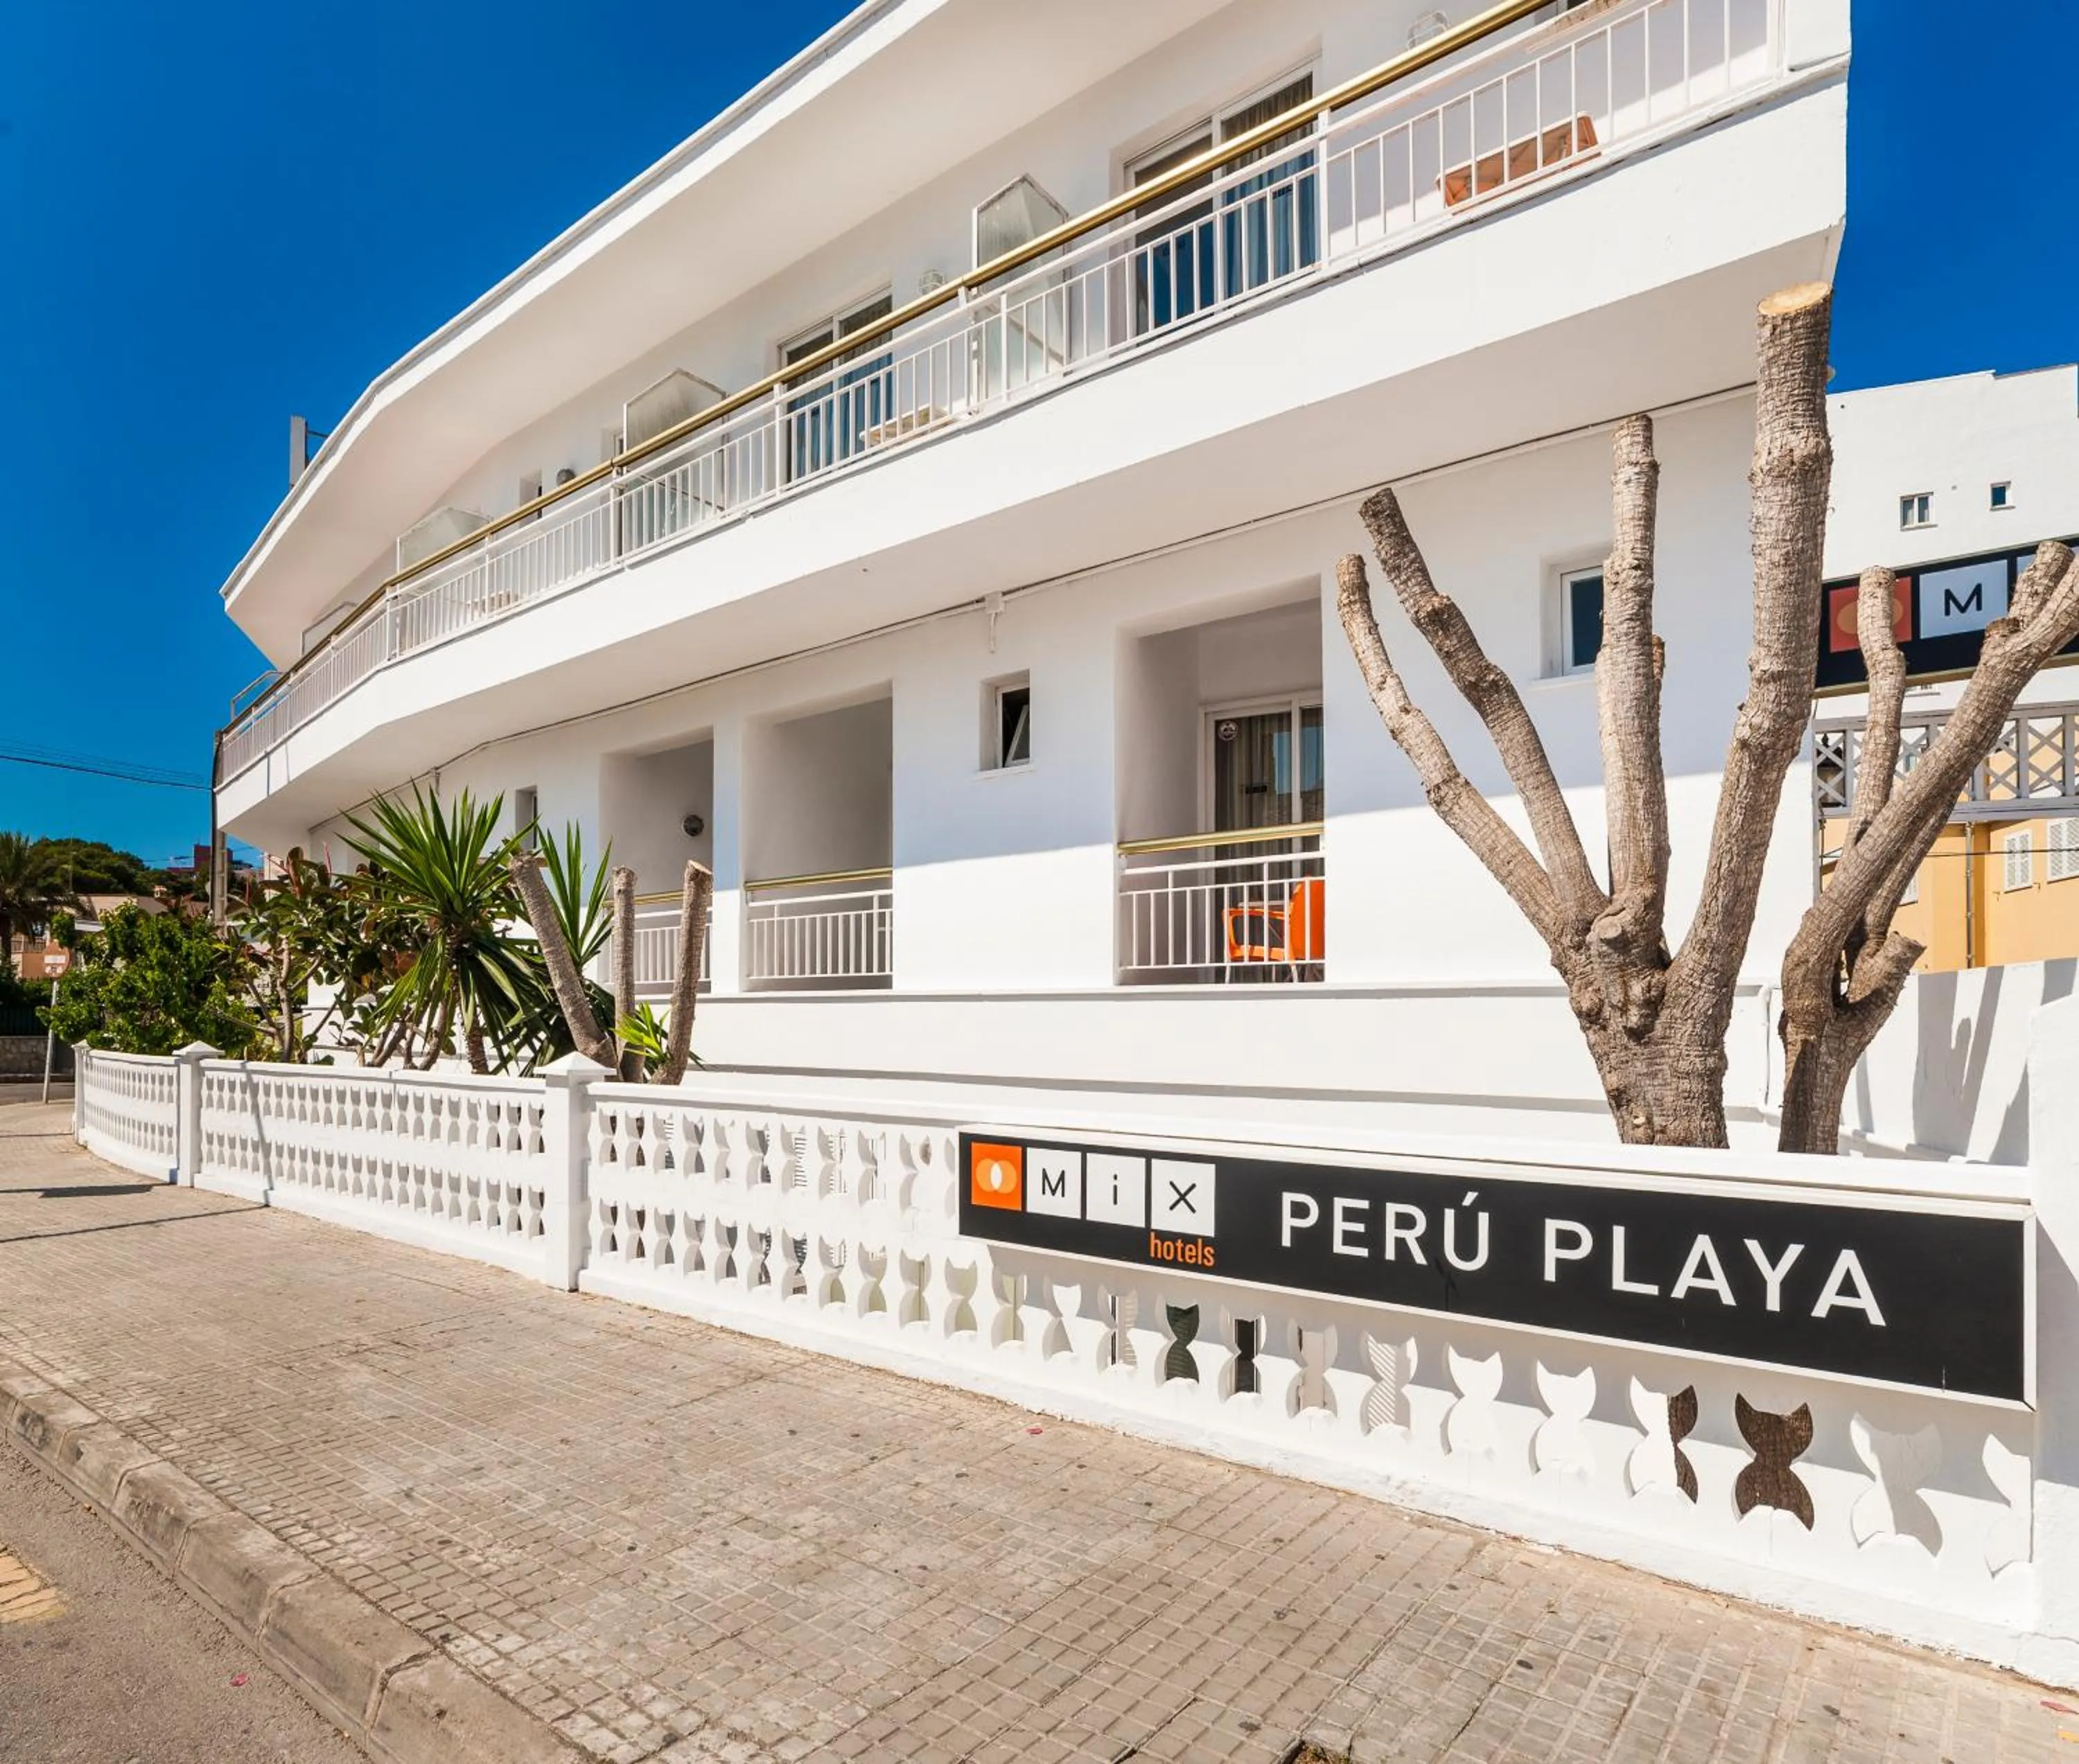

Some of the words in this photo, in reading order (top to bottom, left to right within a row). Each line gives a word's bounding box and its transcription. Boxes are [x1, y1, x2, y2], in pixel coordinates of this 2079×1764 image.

[1148, 1231, 1215, 1268] hotels
[1281, 1191, 1489, 1272] PERÚ
[1543, 1218, 1886, 1327] PLAYA
